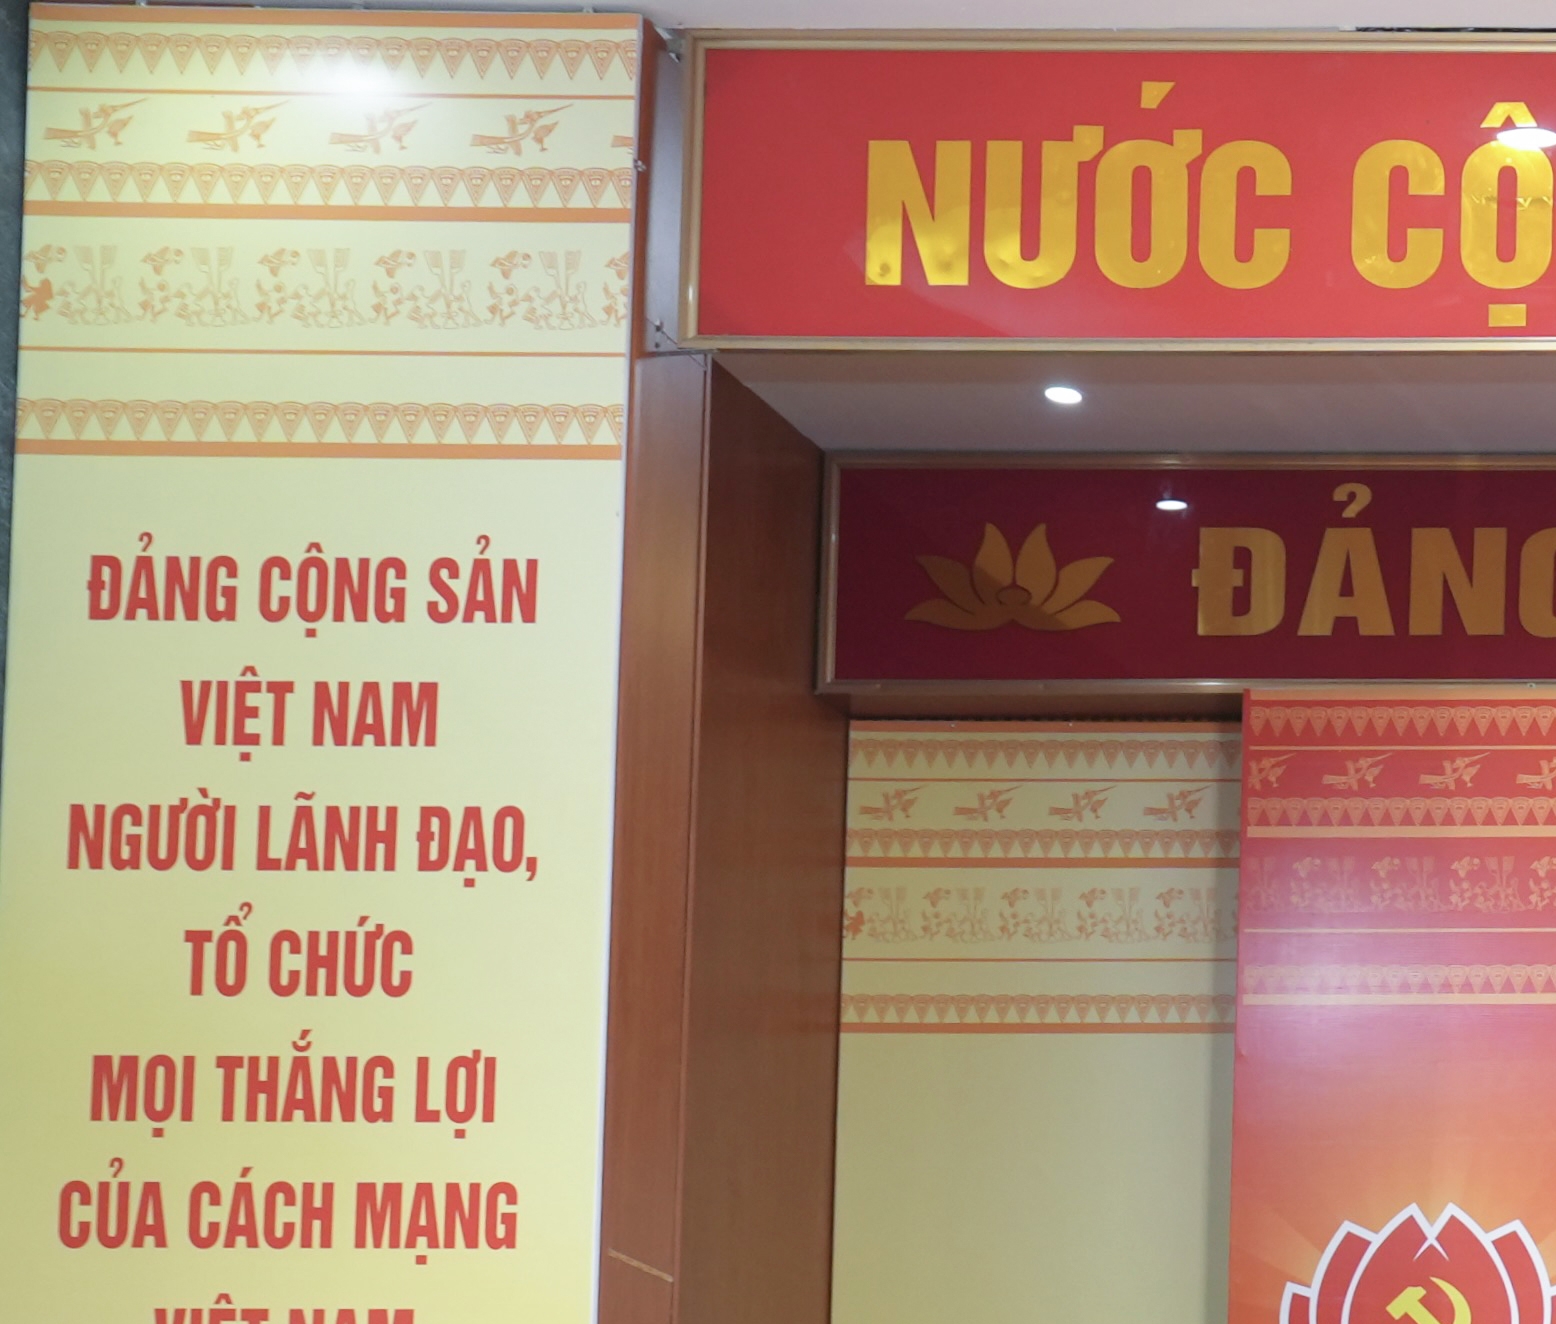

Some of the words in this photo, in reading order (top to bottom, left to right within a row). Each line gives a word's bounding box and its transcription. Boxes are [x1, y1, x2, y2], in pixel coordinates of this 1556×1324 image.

[860, 75, 1292, 298] NƯỚC
[86, 531, 239, 623] ĐẢNG
[258, 541, 408, 639] CỘNG
[426, 534, 540, 625] SẢN
[180, 668, 296, 763] VIỆT
[311, 680, 440, 748] NAM
[67, 786, 238, 873] NGƯỜI
[255, 790, 400, 873] LÃNH
[415, 804, 539, 889] ĐẠO,
[183, 900, 254, 998] TỔ
[268, 914, 415, 999] CHỨC
[90, 1053, 197, 1139] MỌI
[214, 1028, 396, 1125] THẮNG
[414, 1048, 498, 1140] LỢI
[57, 1156, 169, 1250] CỦA
[187, 1166, 336, 1251] CÁCH
[353, 1180, 520, 1266] MẠNG
